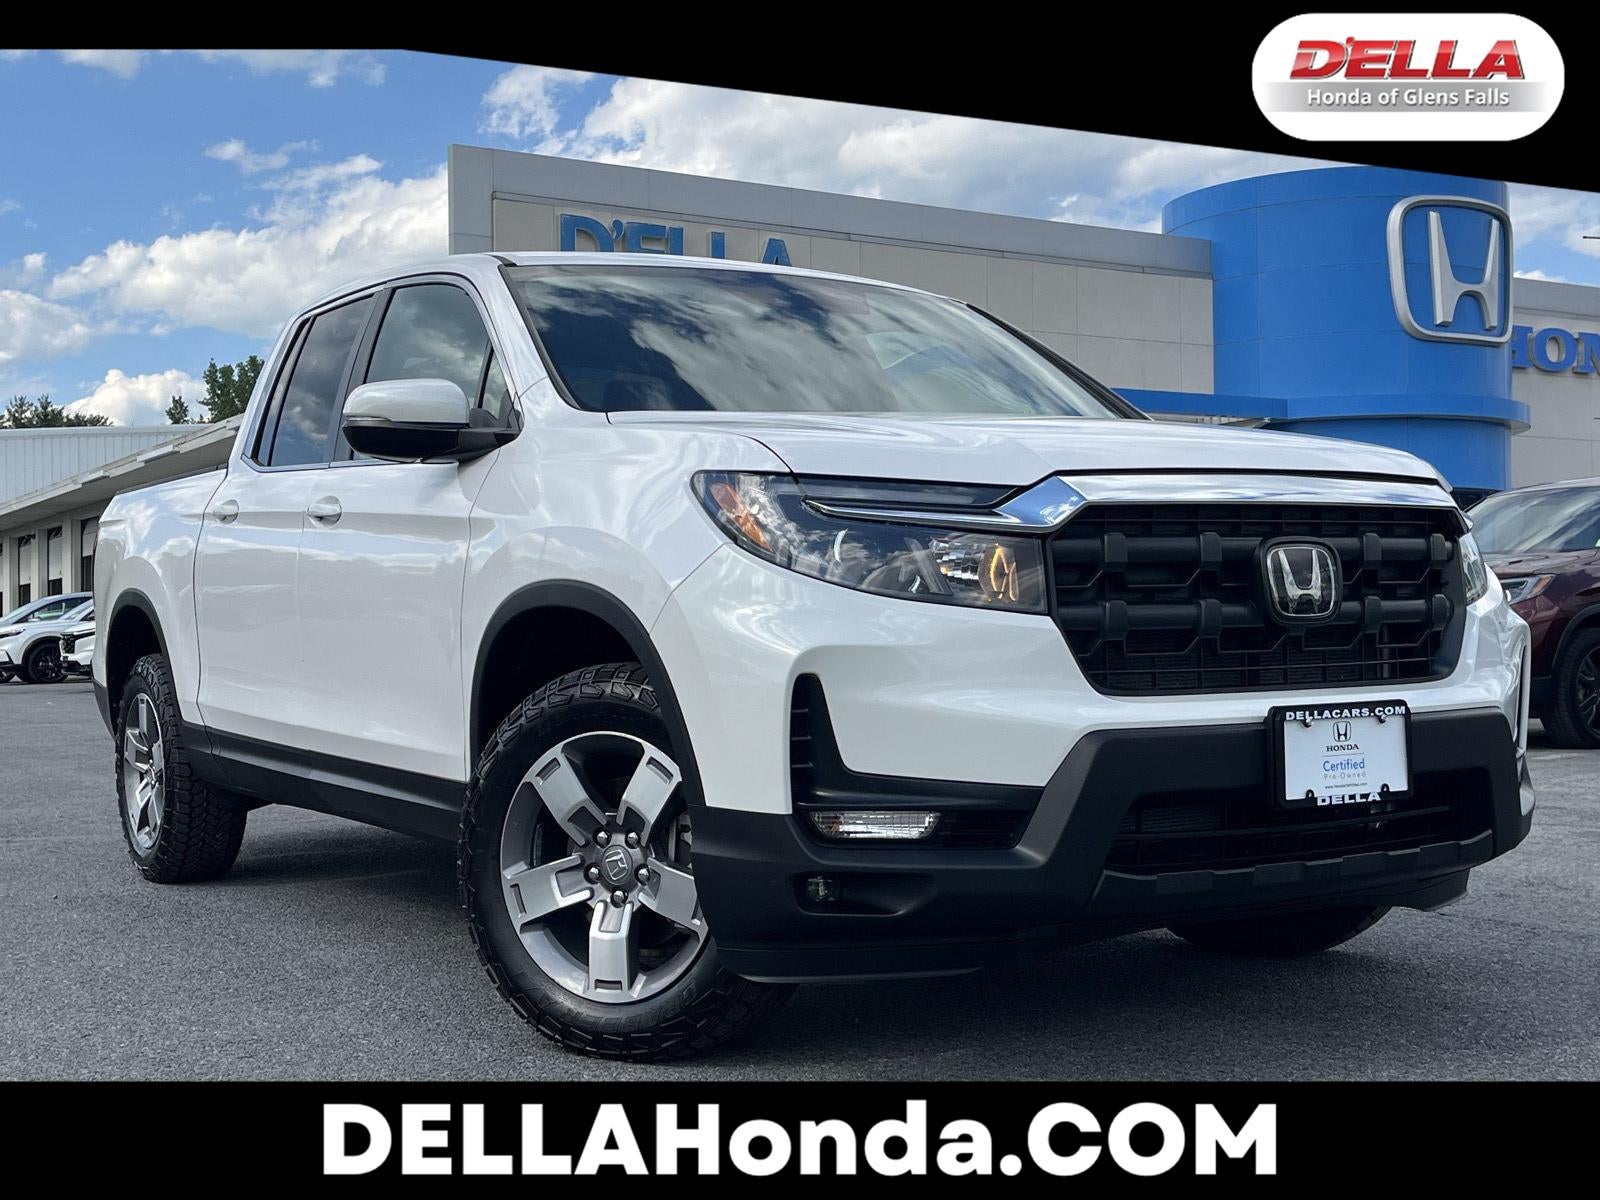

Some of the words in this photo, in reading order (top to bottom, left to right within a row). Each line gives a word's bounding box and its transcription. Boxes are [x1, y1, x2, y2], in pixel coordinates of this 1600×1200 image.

[1285, 705, 1406, 721] DELLACARS.COM
[1326, 743, 1360, 752] HONDA
[1323, 758, 1365, 772] Certified
[1316, 792, 1381, 806] DELLA
